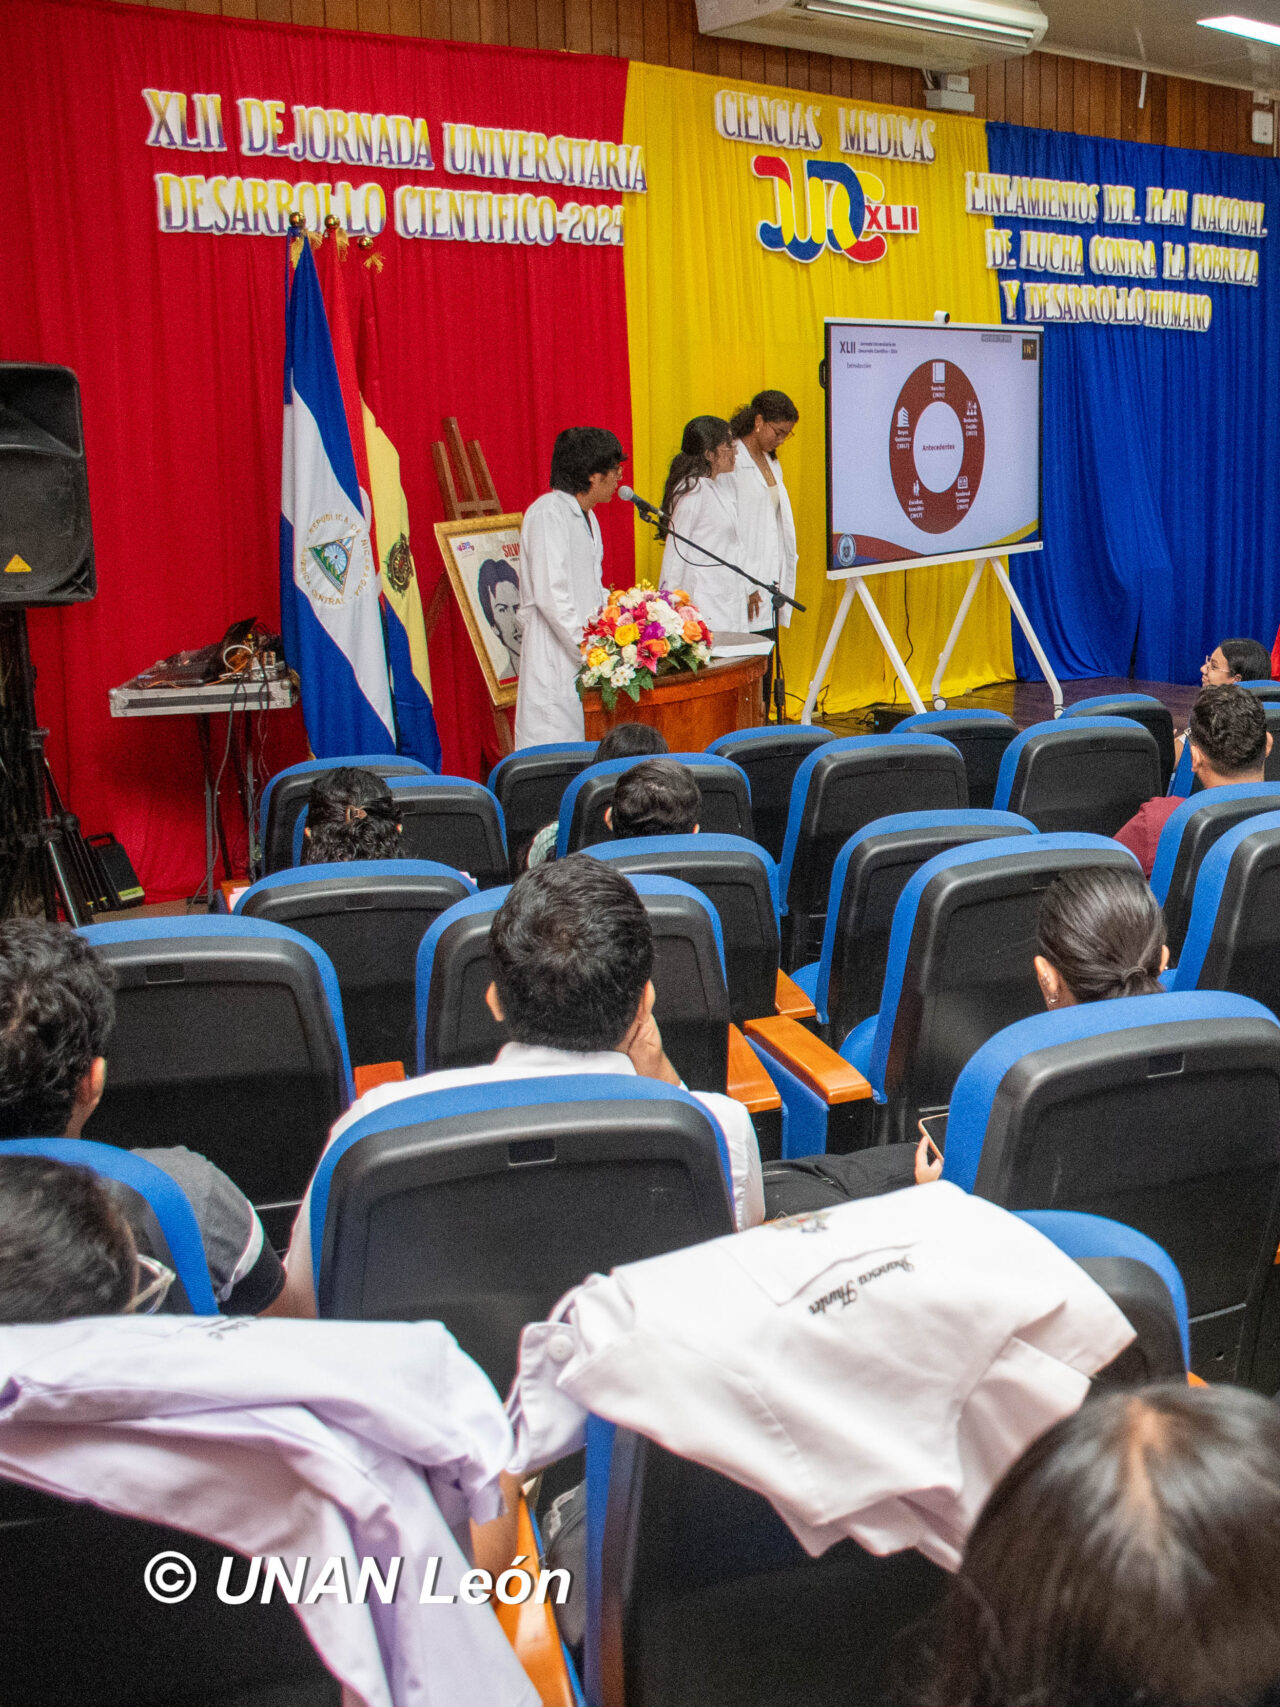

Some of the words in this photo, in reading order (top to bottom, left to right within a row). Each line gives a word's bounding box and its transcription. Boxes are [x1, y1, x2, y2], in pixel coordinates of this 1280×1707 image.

[142, 89, 227, 151] XLII
[236, 98, 290, 156] DE
[291, 105, 434, 170] JORNADA
[442, 122, 648, 193] UNIVERSITARIA
[715, 89, 822, 152] CIENCIAS
[838, 107, 936, 164] MEDICAS
[864, 205, 918, 231] XLII
[965, 171, 1099, 223] LINEAMIENTOS
[1102, 184, 1141, 225] DEL
[1145, 187, 1188, 226] PLAN
[1191, 193, 1268, 238] NACIONAL
[985, 229, 1016, 269] DE
[1020, 231, 1084, 276] LUCHA
[1089, 234, 1157, 279] CONTRA
[1162, 241, 1185, 280] LA
[1188, 242, 1259, 287] POBREZA
[1000, 280, 1020, 320] Y
[1023, 282, 1144, 325] DESARROLLO
[1143, 289, 1212, 332] HUMANO
[840, 341, 855, 353] XLII
